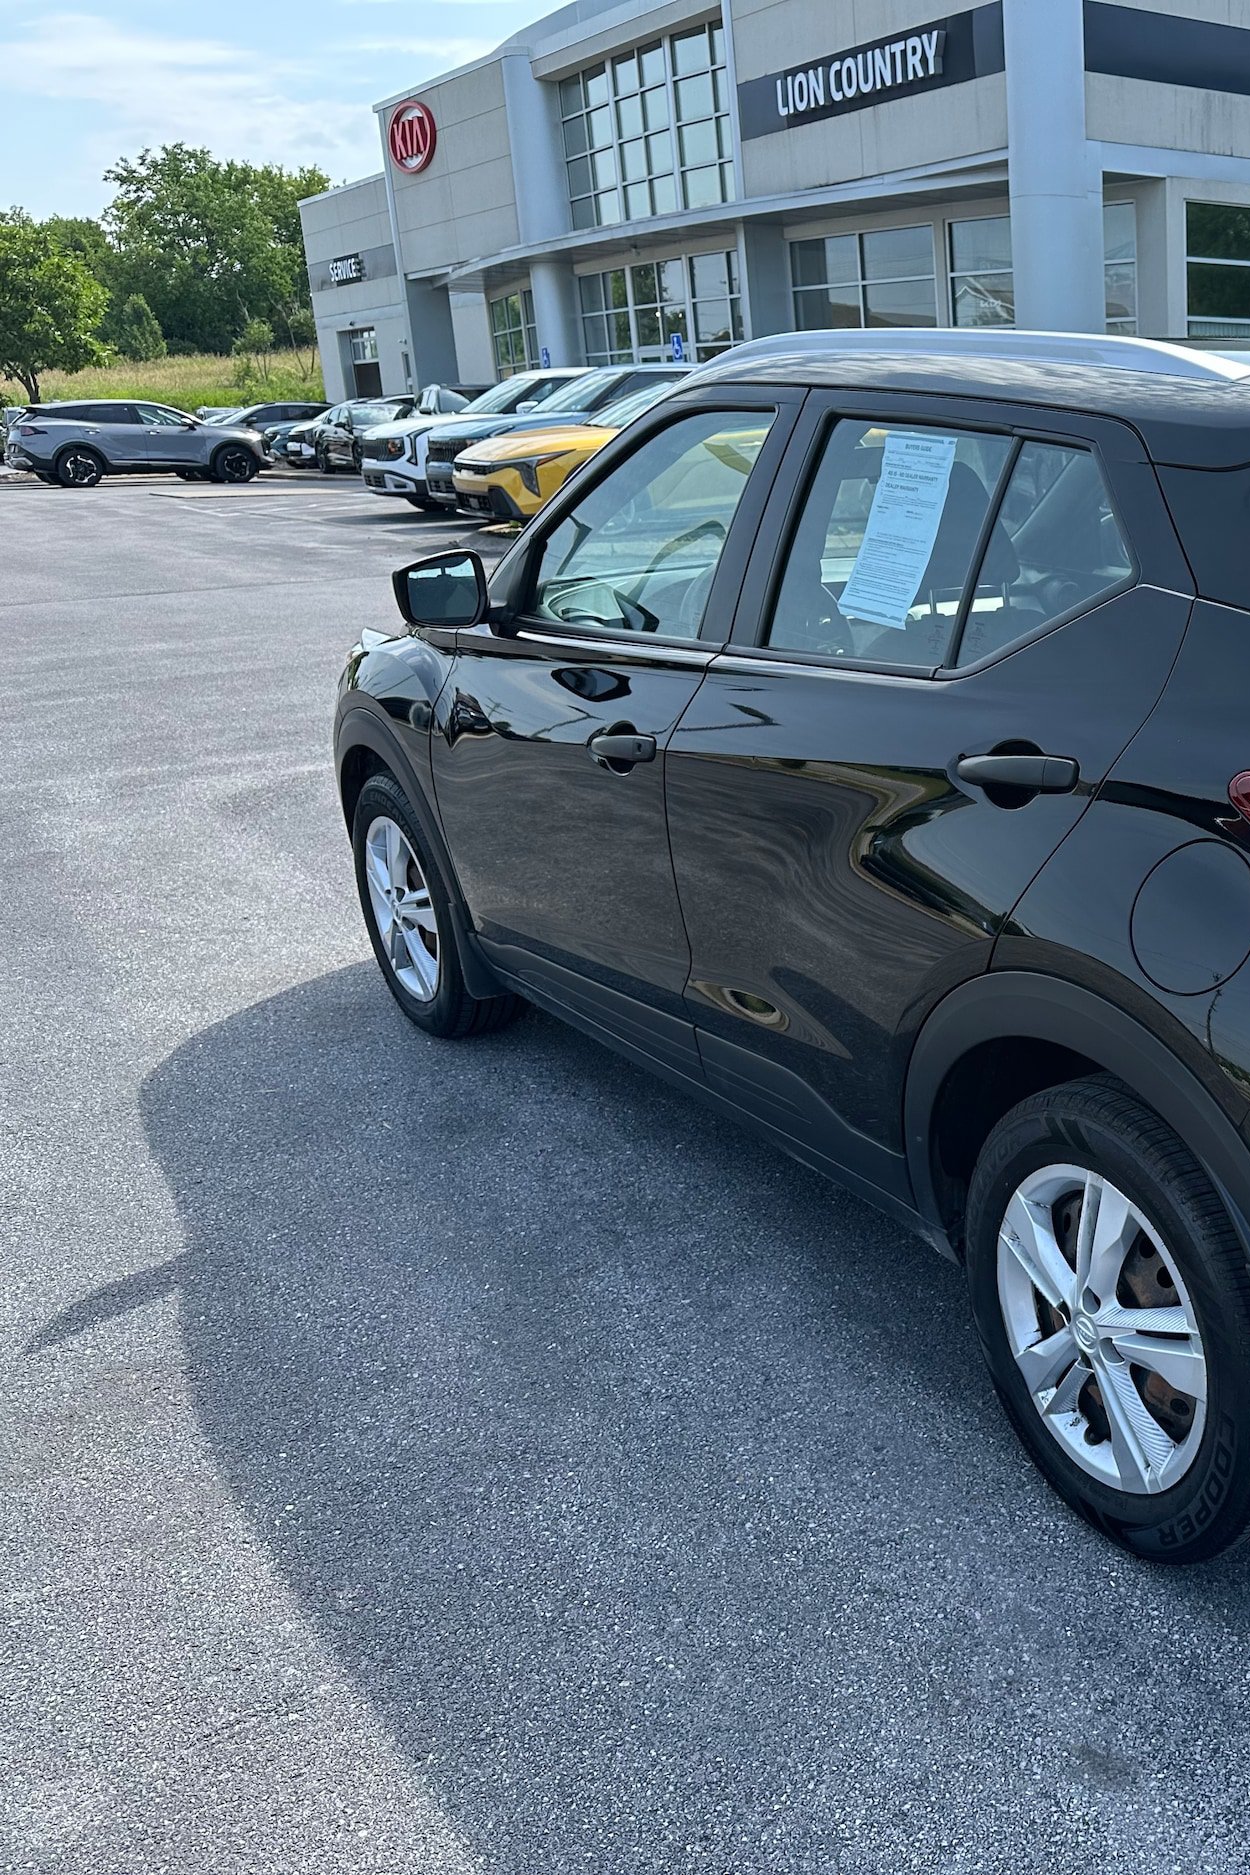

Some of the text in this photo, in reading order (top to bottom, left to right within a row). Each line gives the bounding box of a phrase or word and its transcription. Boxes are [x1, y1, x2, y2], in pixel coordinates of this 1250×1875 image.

[776, 30, 939, 117] LION COUNTRY
[393, 116, 425, 160] KIA
[329, 258, 357, 282] SERVICE
[1157, 1410, 1236, 1547] COOPER
